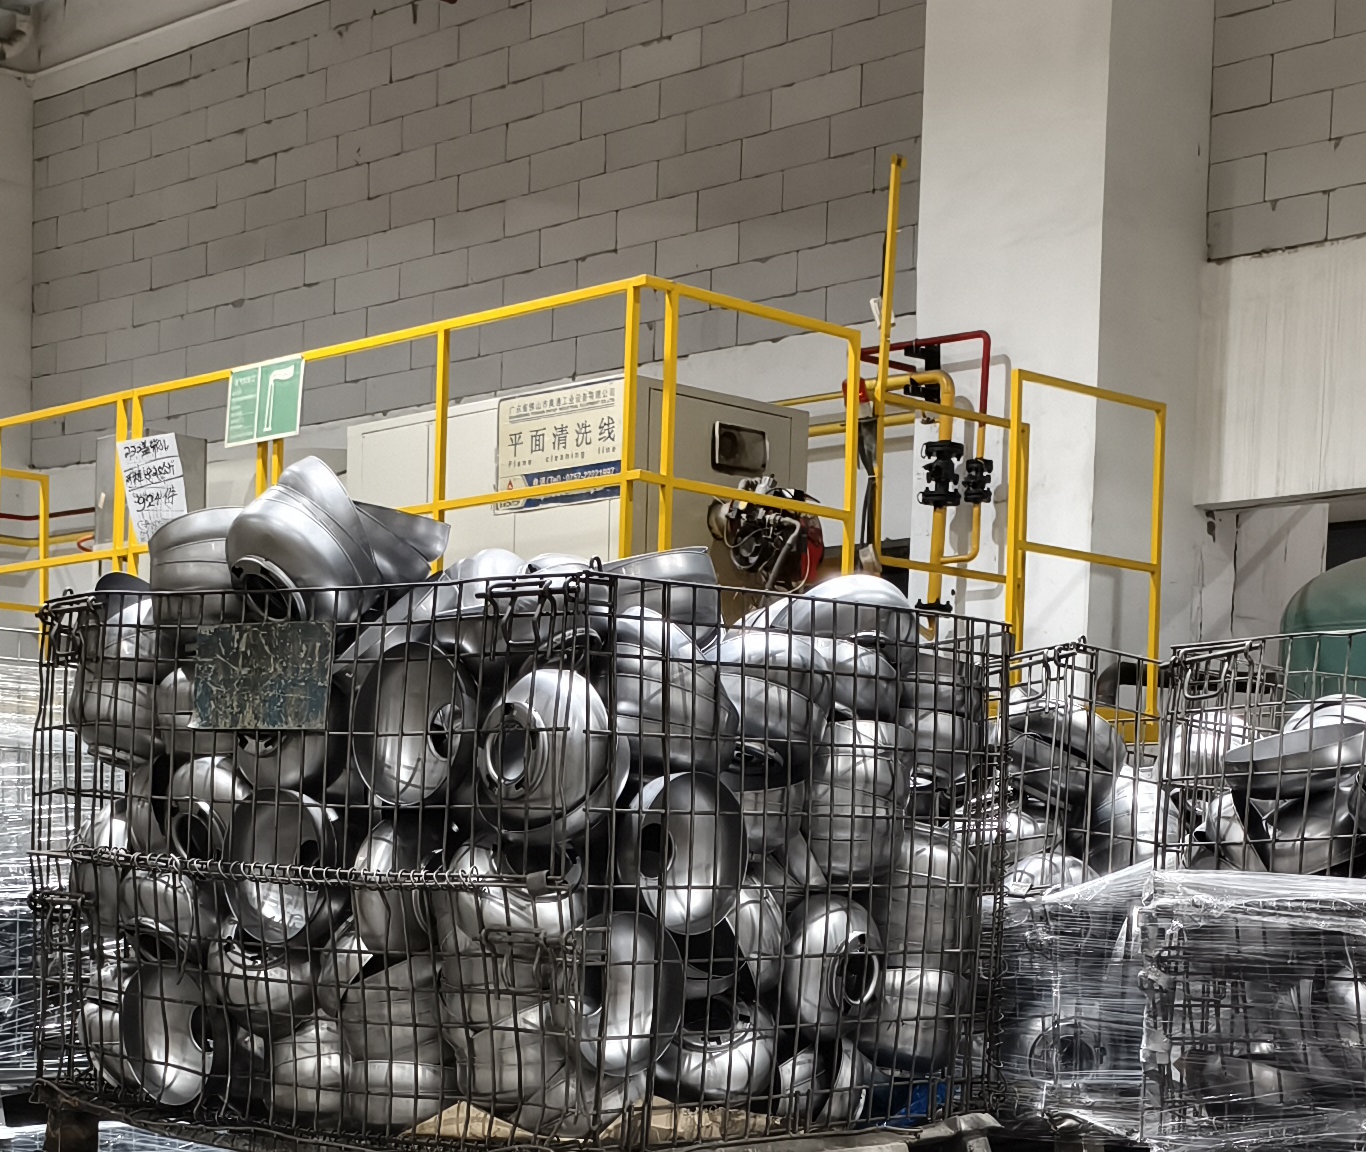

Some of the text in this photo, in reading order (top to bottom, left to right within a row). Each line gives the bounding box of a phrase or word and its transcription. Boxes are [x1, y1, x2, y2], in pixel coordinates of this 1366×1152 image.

[508, 416, 616, 457] 平面清洗线
[545, 451, 585, 463] cleaning
[597, 446, 616, 455] line
